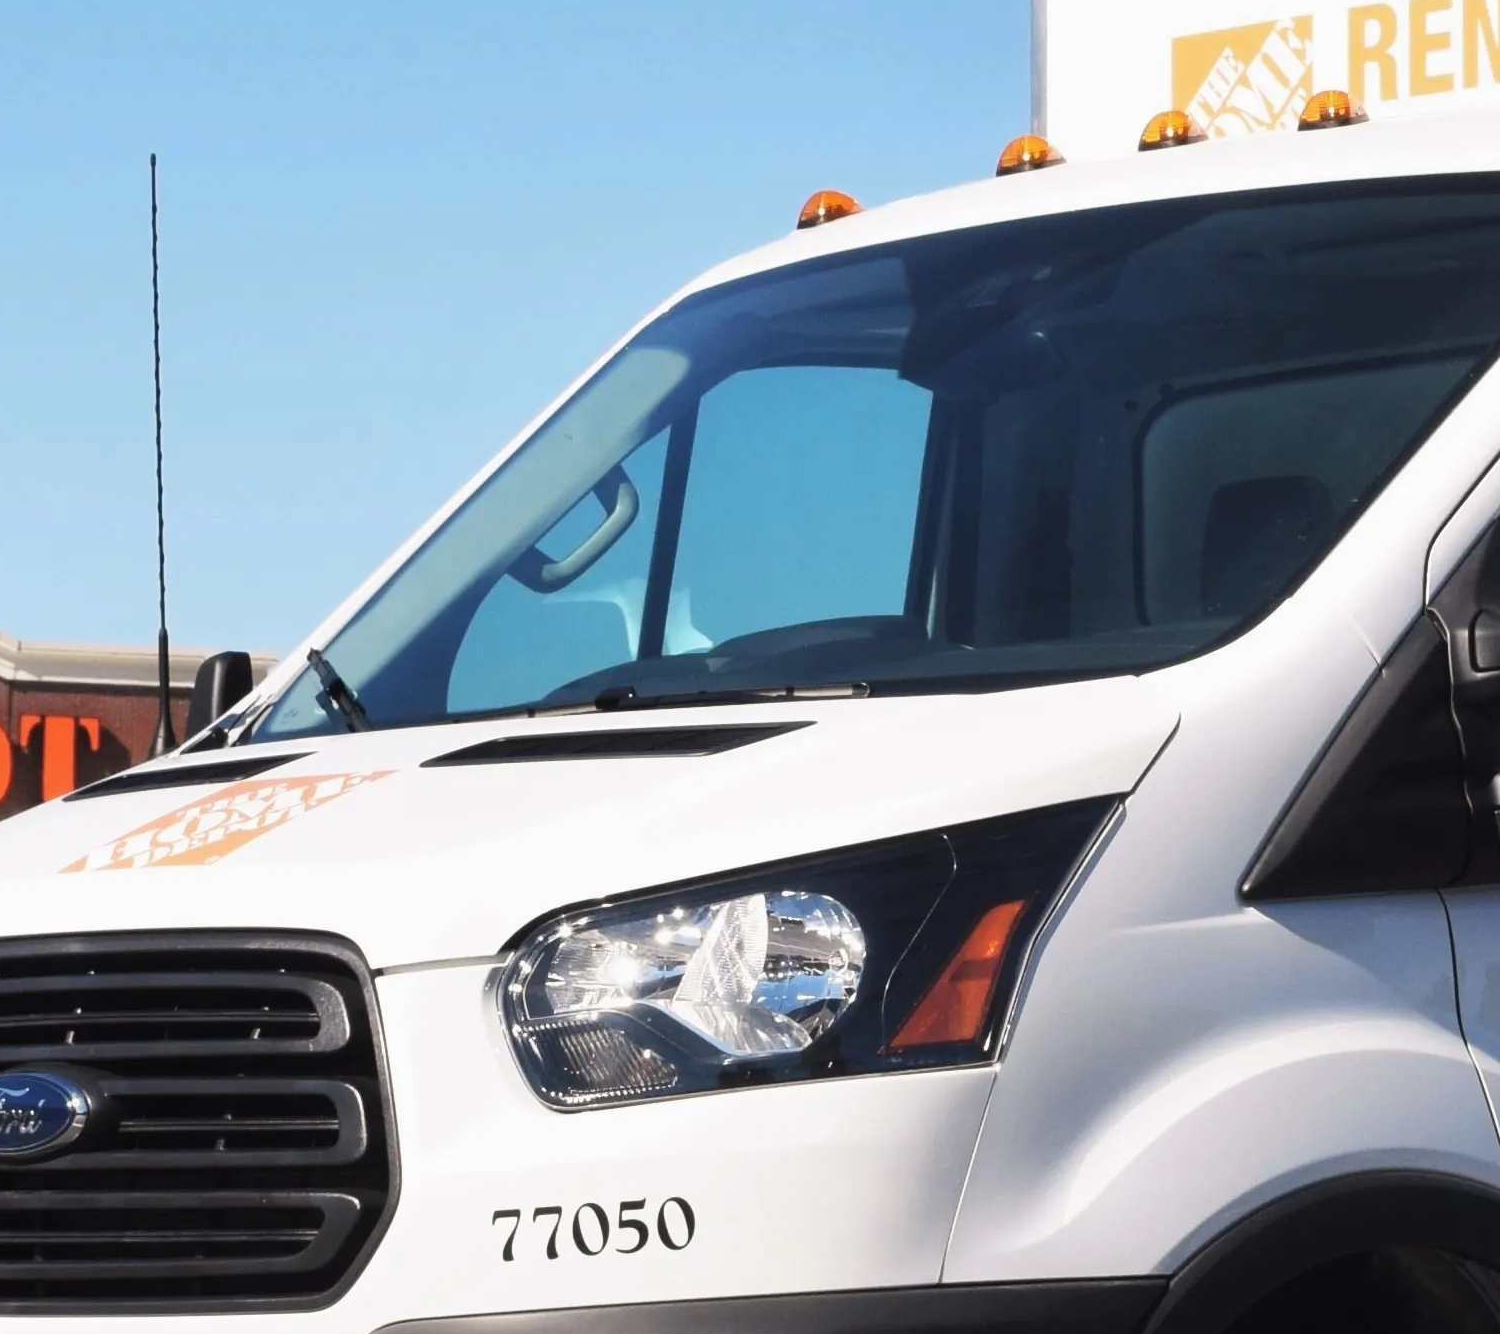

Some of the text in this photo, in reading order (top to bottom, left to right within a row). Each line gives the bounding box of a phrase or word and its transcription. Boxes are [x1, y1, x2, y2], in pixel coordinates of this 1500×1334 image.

[83, 770, 384, 873] HOME
[129, 799, 322, 869] DEPOT
[177, 782, 290, 823] THE
[490, 1195, 696, 1262] 77050
